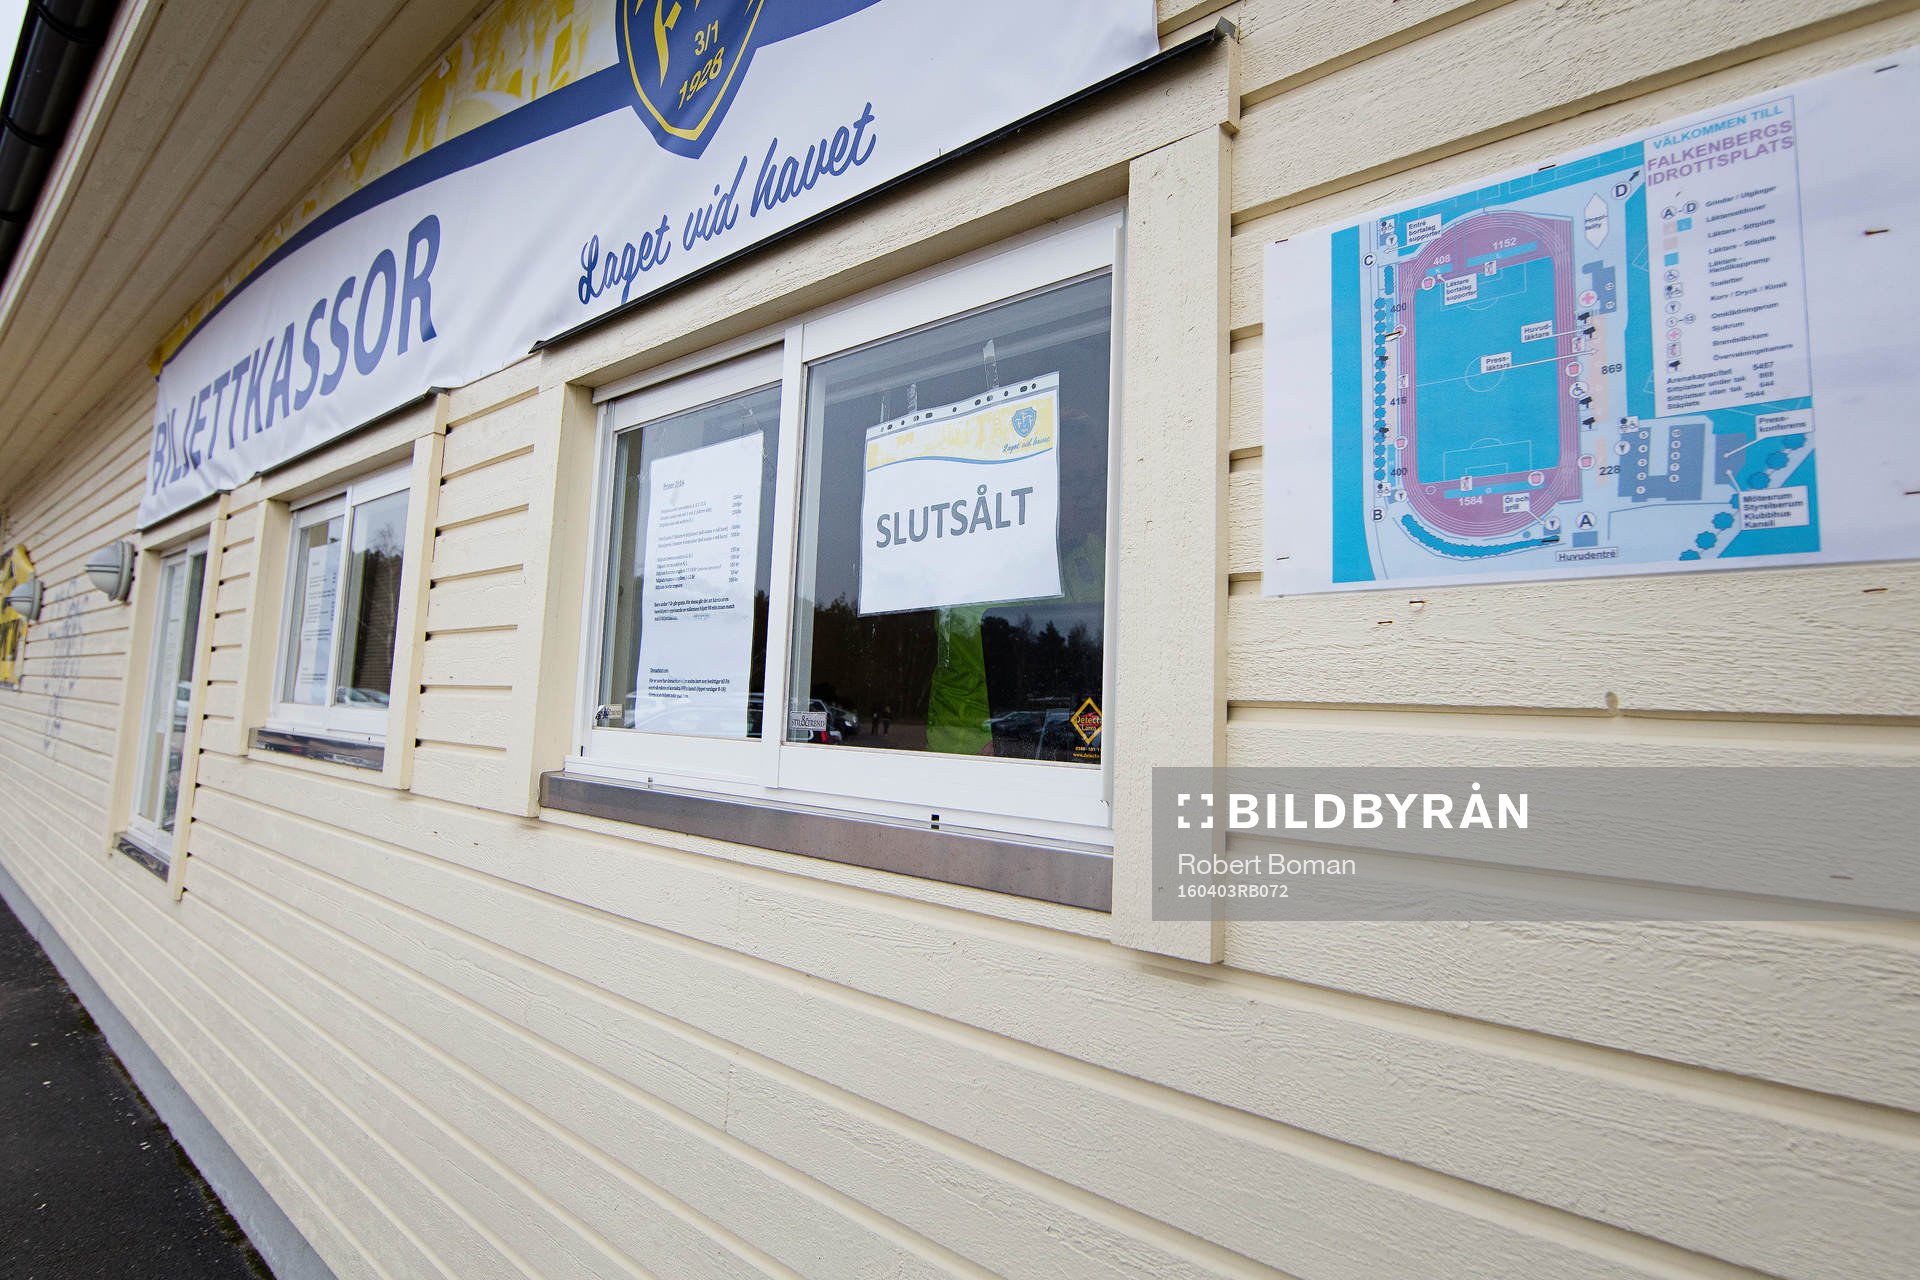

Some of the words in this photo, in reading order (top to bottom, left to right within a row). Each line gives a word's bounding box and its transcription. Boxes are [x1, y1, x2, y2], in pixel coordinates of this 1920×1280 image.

[695, 20, 719, 56] 3/1
[677, 47, 725, 110] 1928
[1653, 115, 1747, 150] VÄLKOMMEN
[1751, 105, 1783, 121] TILL
[1647, 120, 1793, 171] FALKENBERGS
[1647, 136, 1794, 187] IDROTTSPLATS
[1615, 183, 1629, 198] D
[578, 214, 671, 306] Laget
[682, 156, 749, 249] vid
[750, 102, 877, 218] havet
[1663, 208, 1675, 220] A
[1408, 224, 1436, 237] bortalag
[1408, 229, 1441, 243] supporter
[1492, 237, 1518, 250] 1152
[1363, 254, 1374, 266] C
[1432, 254, 1451, 266] 408
[1446, 278, 1470, 288] Läktare
[1446, 284, 1472, 295] bortalag
[1446, 290, 1477, 301] supporter
[1524, 324, 1552, 334] Huvud-
[1524, 331, 1550, 341] läktare
[151, 213, 442, 496] BILJETTKASSOR
[1485, 356, 1510, 365] Press-
[1485, 362, 1511, 372] läktare
[1601, 363, 1623, 375] 869
[1390, 467, 1408, 478] 400
[1599, 465, 1621, 476] 228
[1458, 496, 1483, 507] 1584
[1504, 494, 1515, 504] Öl
[1516, 494, 1530, 503] och
[1504, 502, 1520, 513] grill
[875, 484, 1034, 550] SLUTSÅLT
[1372, 509, 1383, 520] B
[1579, 513, 1594, 528] A
[1558, 550, 1616, 562] Huvudentré
